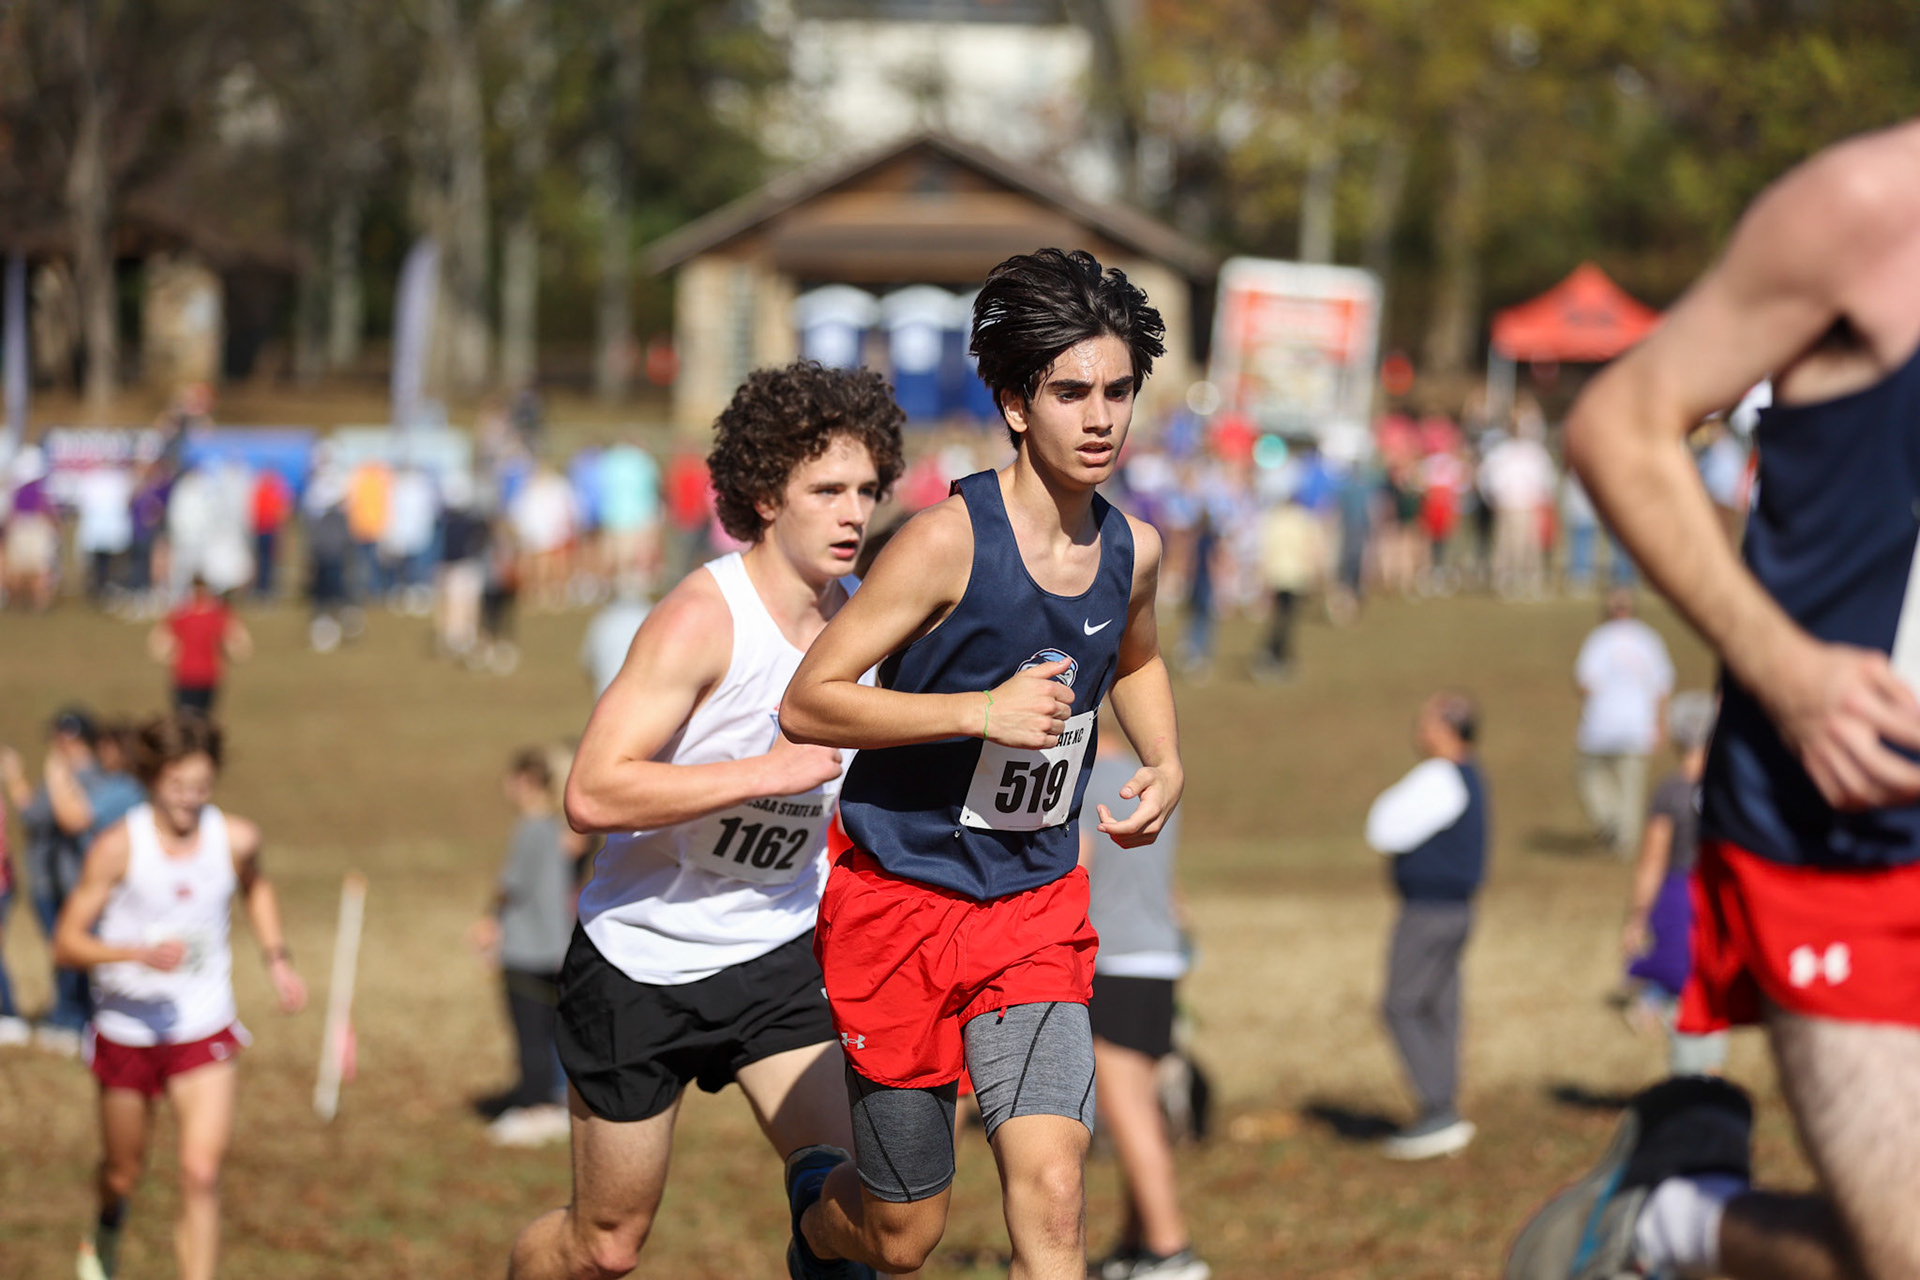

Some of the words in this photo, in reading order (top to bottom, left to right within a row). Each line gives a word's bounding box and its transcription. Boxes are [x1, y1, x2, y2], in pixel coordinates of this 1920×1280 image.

[1056, 730, 1073, 747] ATE
[1073, 728, 1084, 745] XC
[995, 759, 1069, 814] 519
[747, 799, 778, 814] SAA
[778, 803, 811, 818] STATE
[712, 816, 809, 871] 1162
